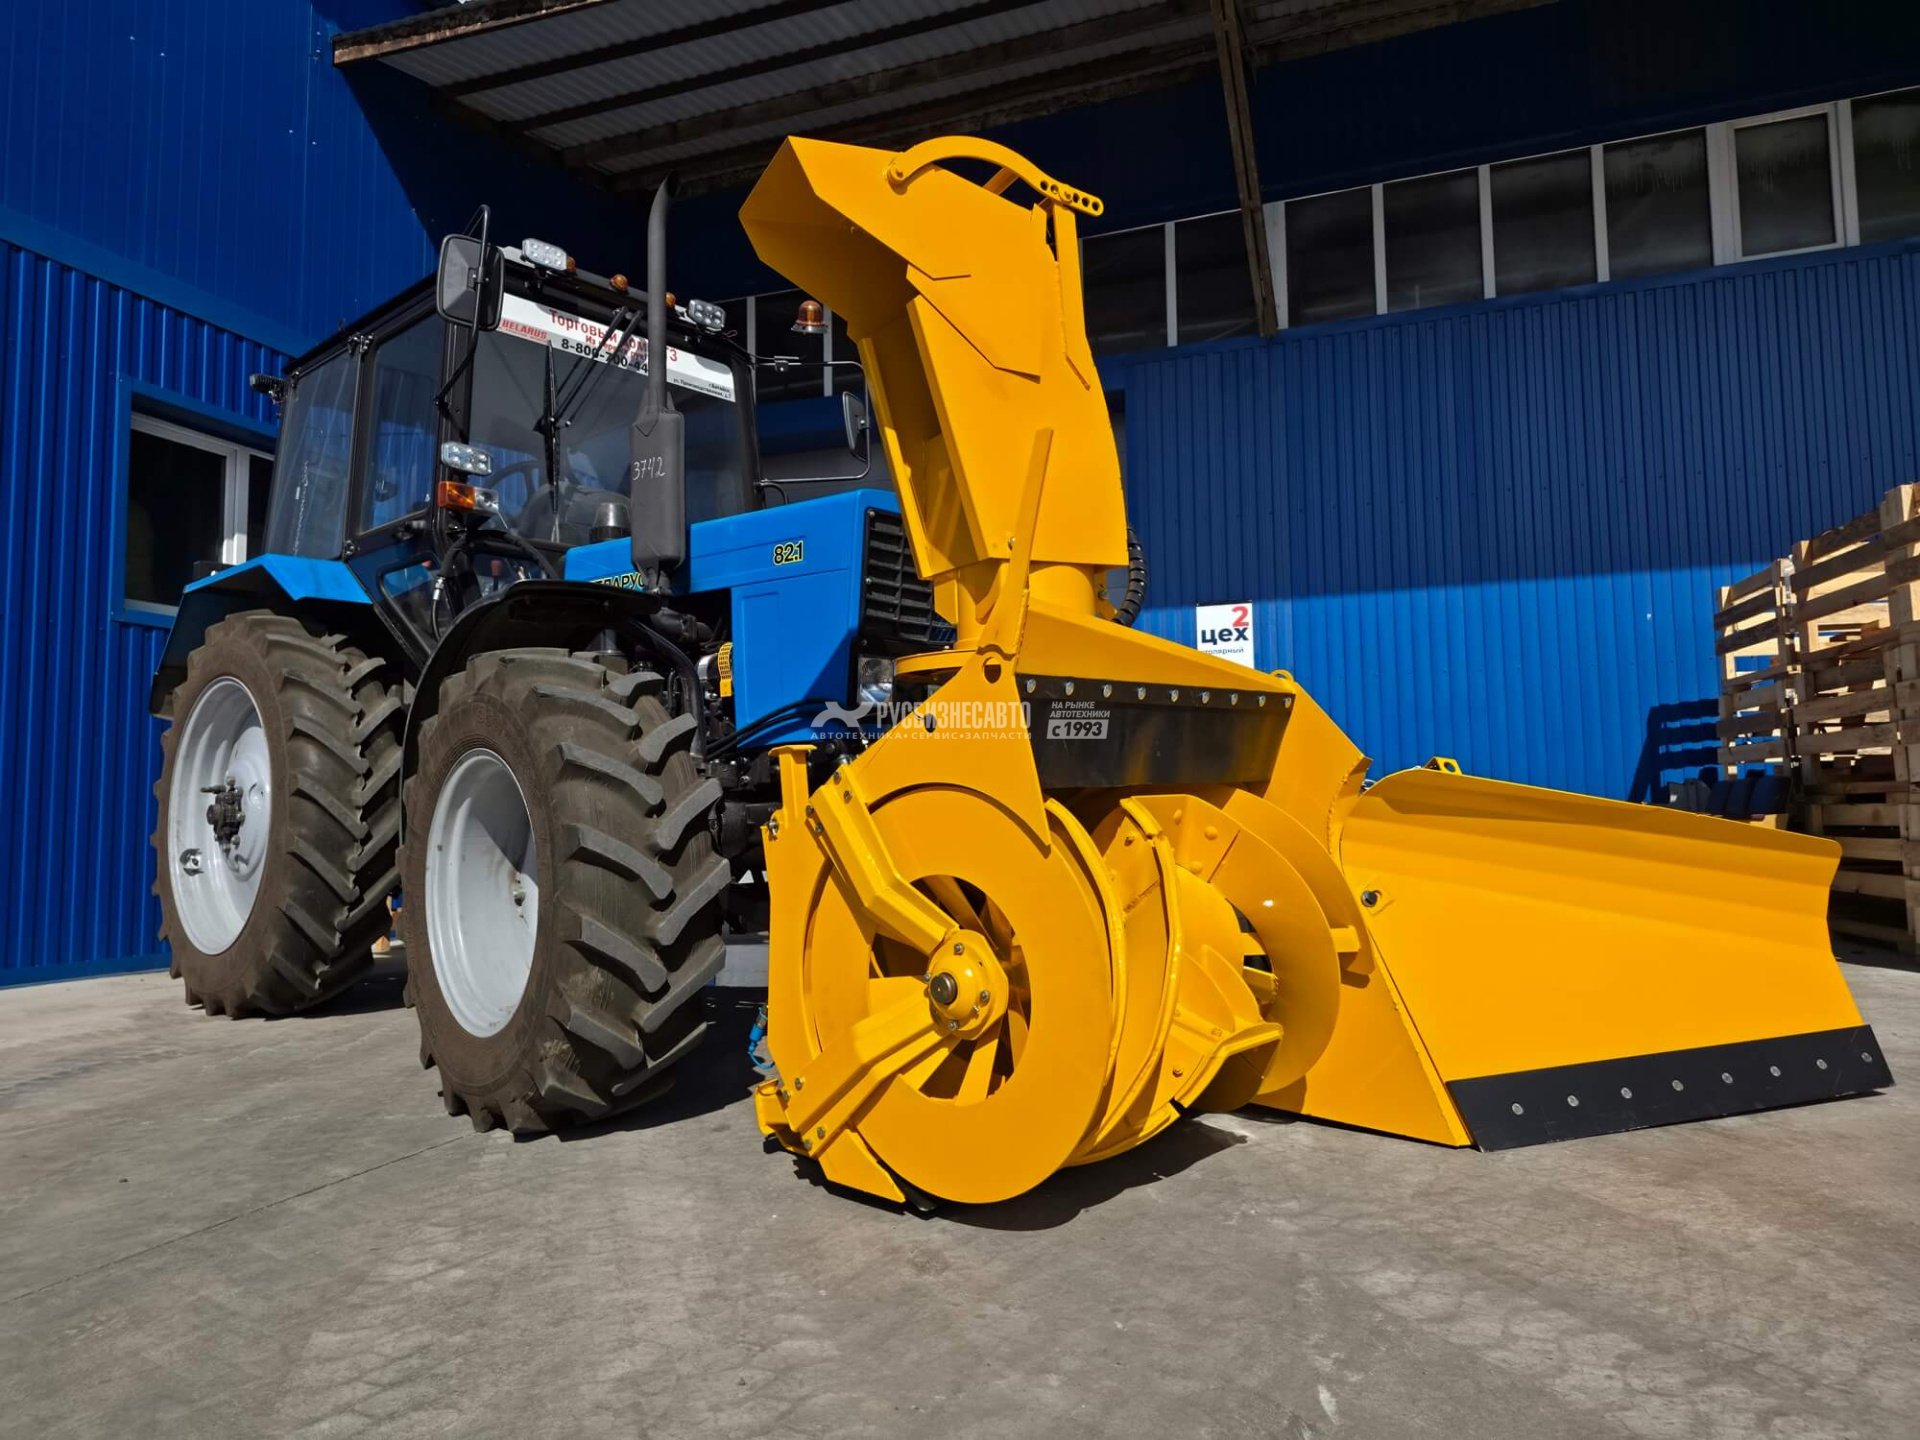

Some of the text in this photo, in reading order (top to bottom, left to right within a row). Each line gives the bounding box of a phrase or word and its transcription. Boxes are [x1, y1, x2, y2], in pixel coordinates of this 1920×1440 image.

[501, 318, 548, 340] BELARUS
[632, 457, 665, 480] 3742
[773, 540, 804, 566] 82.1
[1232, 606, 1249, 628] 2
[1201, 627, 1249, 646] цех
